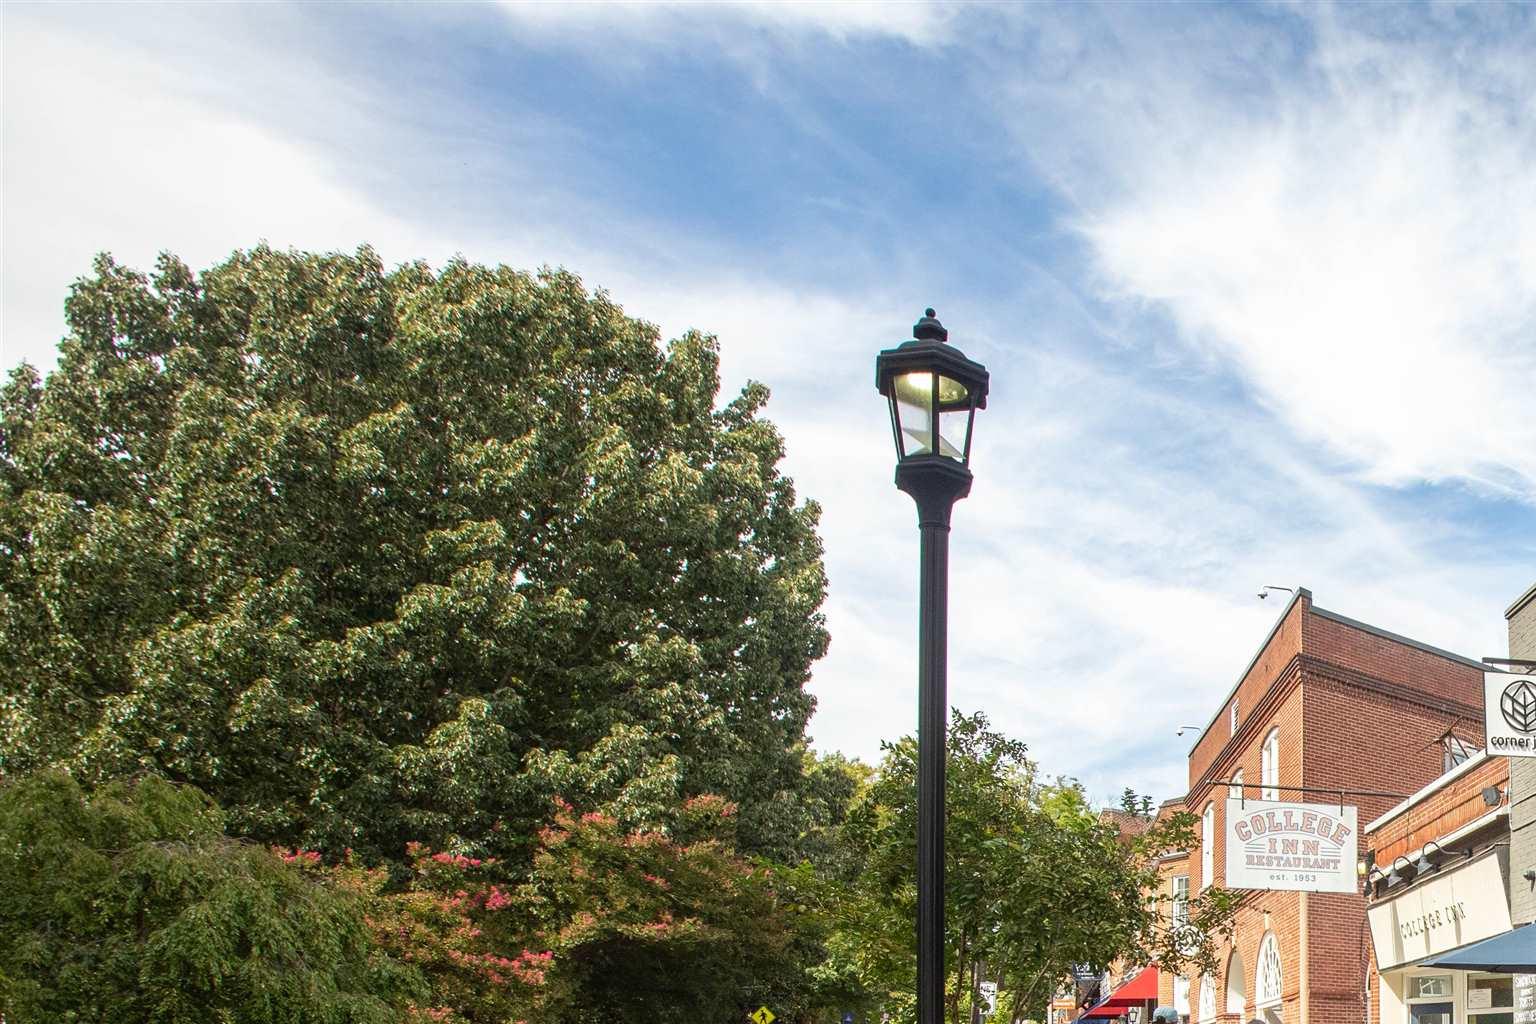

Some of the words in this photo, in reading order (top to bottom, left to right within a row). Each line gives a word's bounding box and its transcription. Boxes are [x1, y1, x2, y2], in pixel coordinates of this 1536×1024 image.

[1491, 736, 1531, 747] corner
[1235, 810, 1351, 846] COLLEGE
[1268, 838, 1320, 855] INN
[1245, 854, 1340, 870] RESTAURANT
[1400, 909, 1443, 939] COLLEGE
